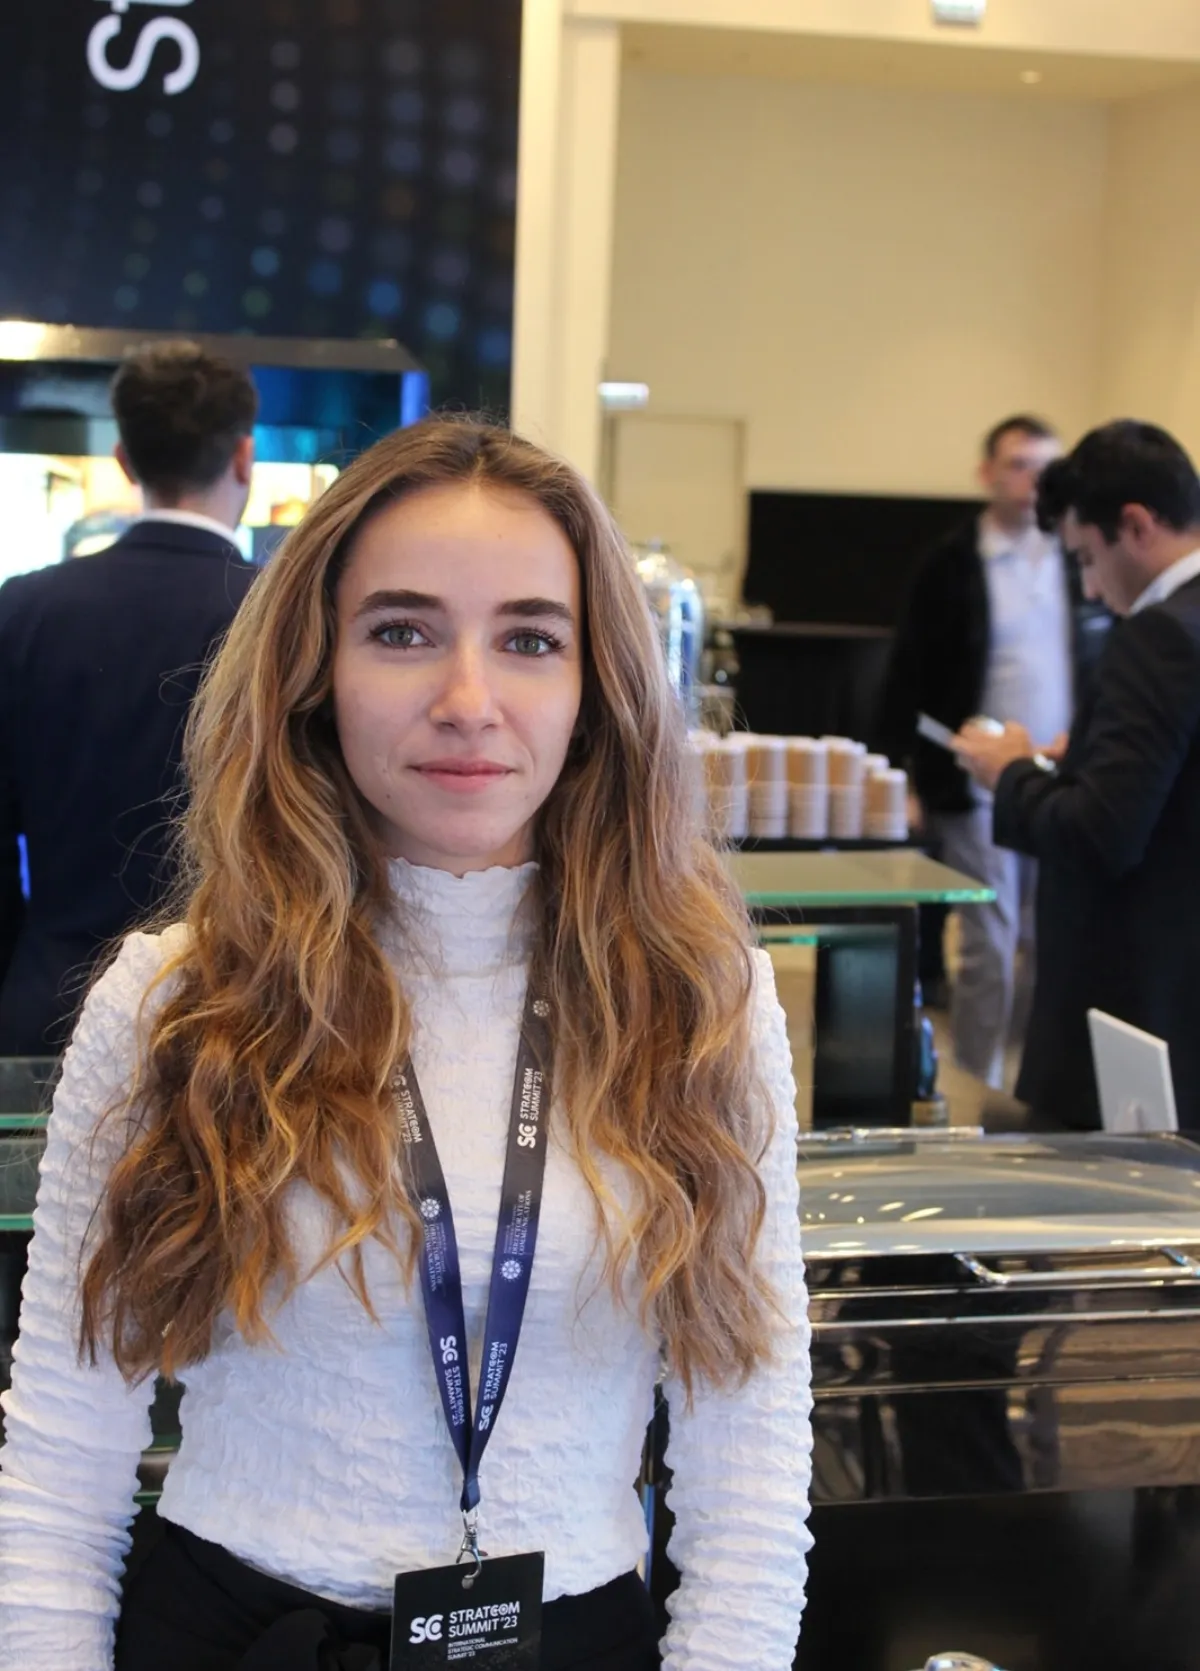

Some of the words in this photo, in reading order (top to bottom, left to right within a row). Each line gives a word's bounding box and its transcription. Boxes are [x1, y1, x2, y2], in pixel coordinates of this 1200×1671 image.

[87, 0, 199, 95] S
[519, 1067, 534, 1120] STRATCOM
[529, 1084, 542, 1122] SUMMIT
[400, 1089, 423, 1143] STRATCOM
[517, 1122, 538, 1149] SC
[440, 1335, 458, 1364] SC
[444, 1368, 457, 1411] SUMMIT
[483, 1341, 500, 1401] STRATCOM
[490, 1358, 505, 1400] SUMMIT
[452, 1365, 465, 1425] STRATCOM
[478, 1404, 494, 1431] SC
[409, 1614, 444, 1644] SC
[448, 1618, 500, 1638] SUMMIT
[449, 1600, 520, 1624] STRATCOM
